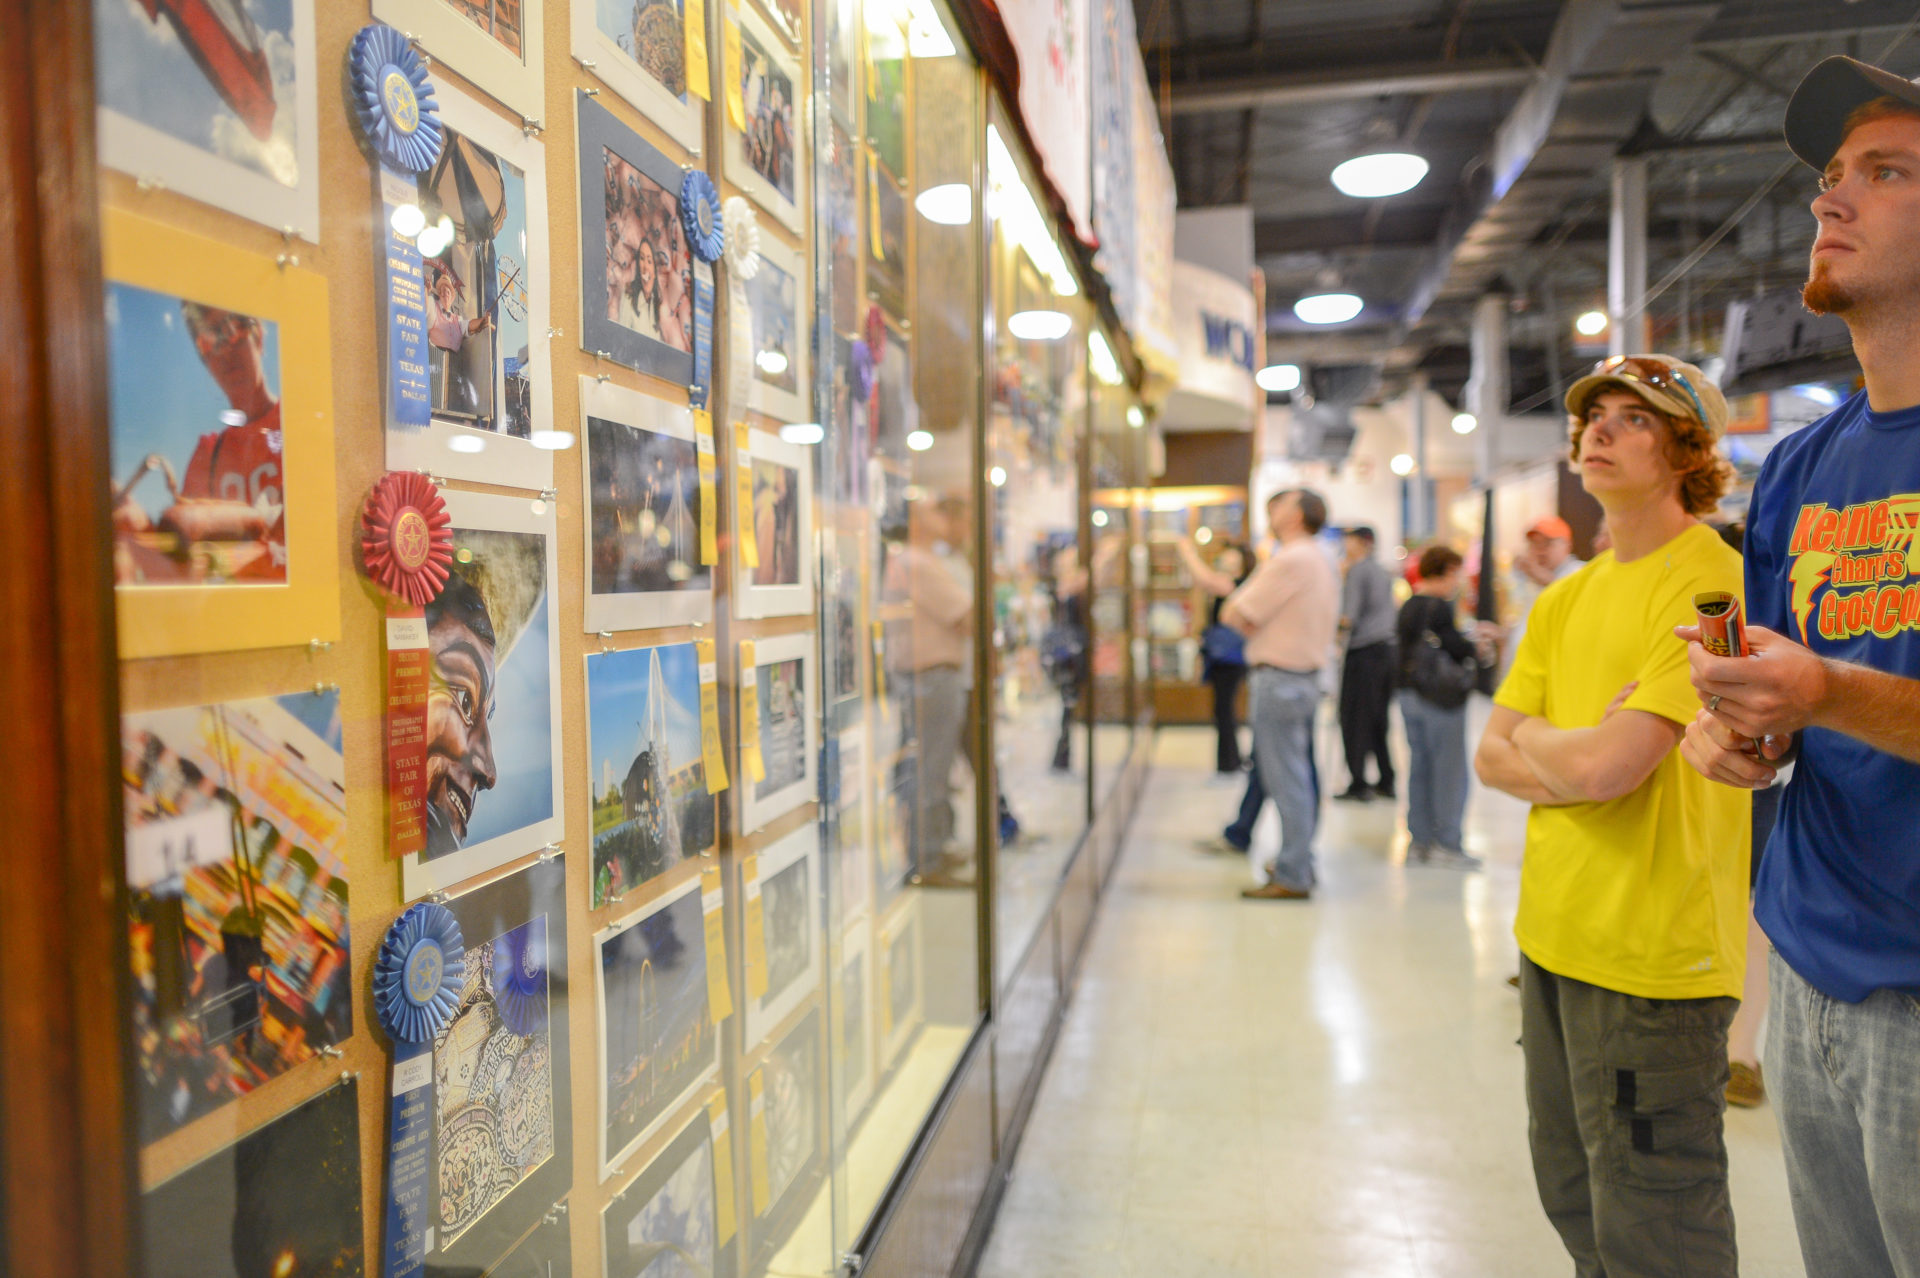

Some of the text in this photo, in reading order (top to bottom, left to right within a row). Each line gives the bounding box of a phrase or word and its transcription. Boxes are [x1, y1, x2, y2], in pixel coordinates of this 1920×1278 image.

[396, 313, 421, 330] STATE
[401, 330, 419, 344] FAIR
[399, 360, 424, 376] TEXAS
[402, 389, 426, 402] DALLAS
[1789, 501, 1889, 555] Keene
[396, 756, 420, 769] STATE
[400, 770, 418, 782] FAIR
[404, 786, 414, 795] OF
[398, 798, 421, 812] TEXAS
[397, 828, 420, 840] DALLAS
[395, 1185, 421, 1206] STATE
[399, 1202, 418, 1219] FAIR
[402, 1219, 414, 1233] OF
[394, 1231, 420, 1252] TEXAS
[394, 1259, 420, 1278] DALLAS
